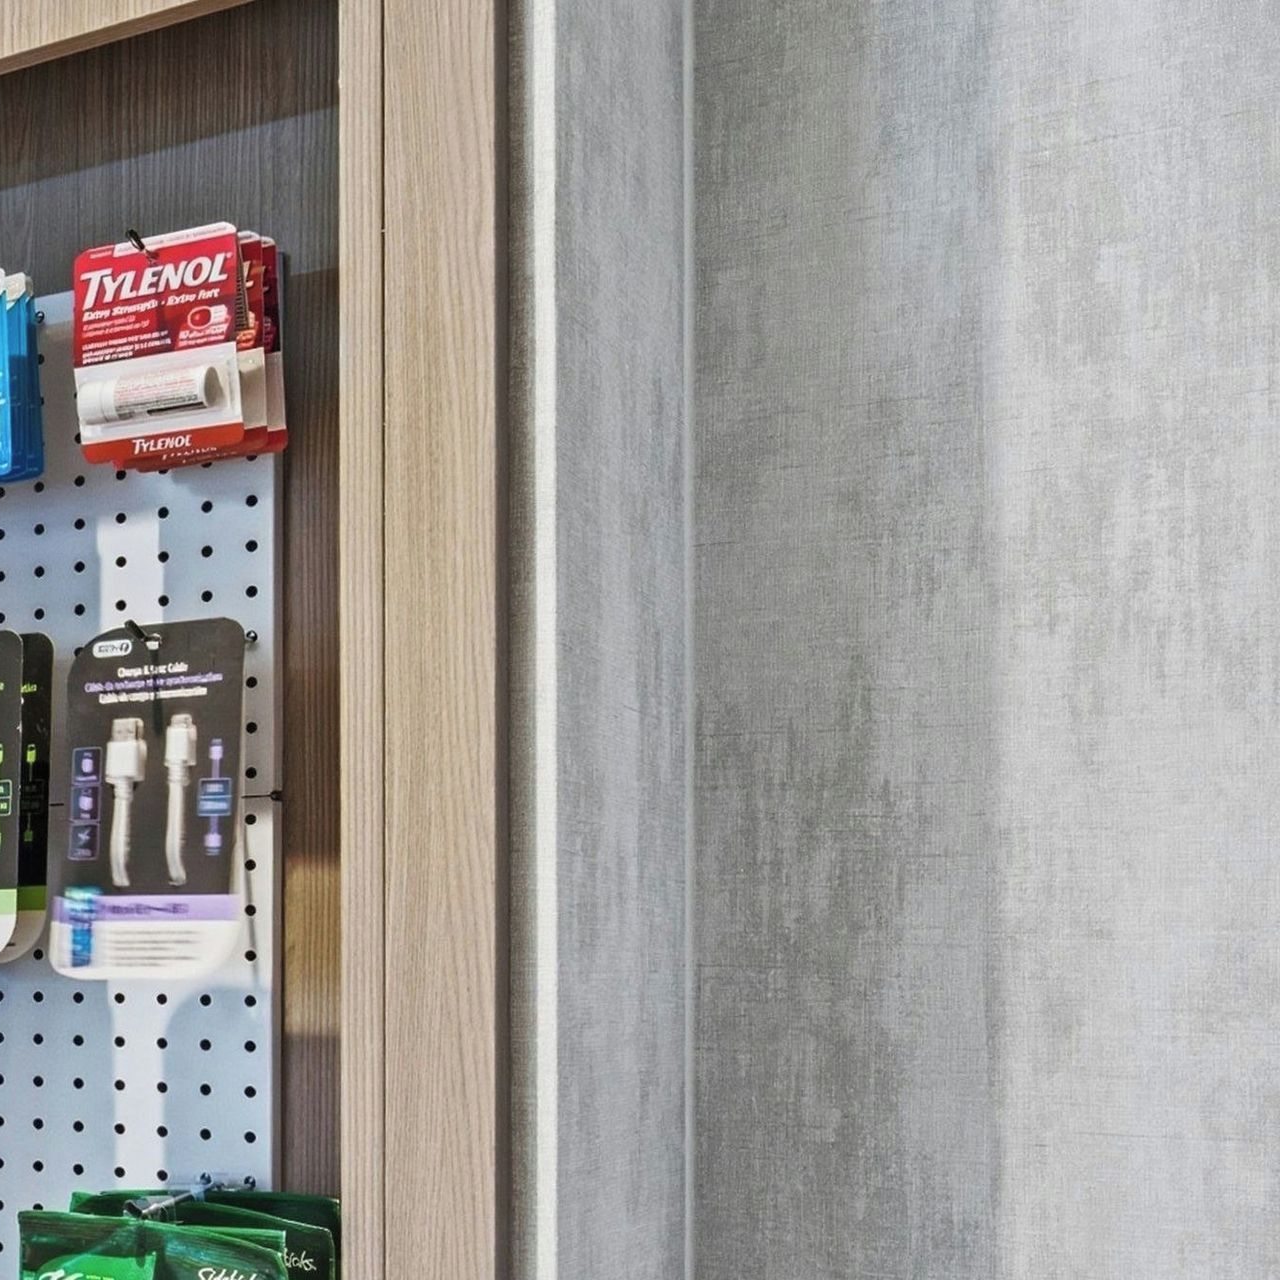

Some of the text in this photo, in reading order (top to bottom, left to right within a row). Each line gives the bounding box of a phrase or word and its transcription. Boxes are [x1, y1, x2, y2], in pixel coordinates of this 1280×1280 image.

[80, 252, 228, 310] TYLENOL
[132, 434, 192, 455] TYLENOL
[283, 1247, 317, 1271] kicks
